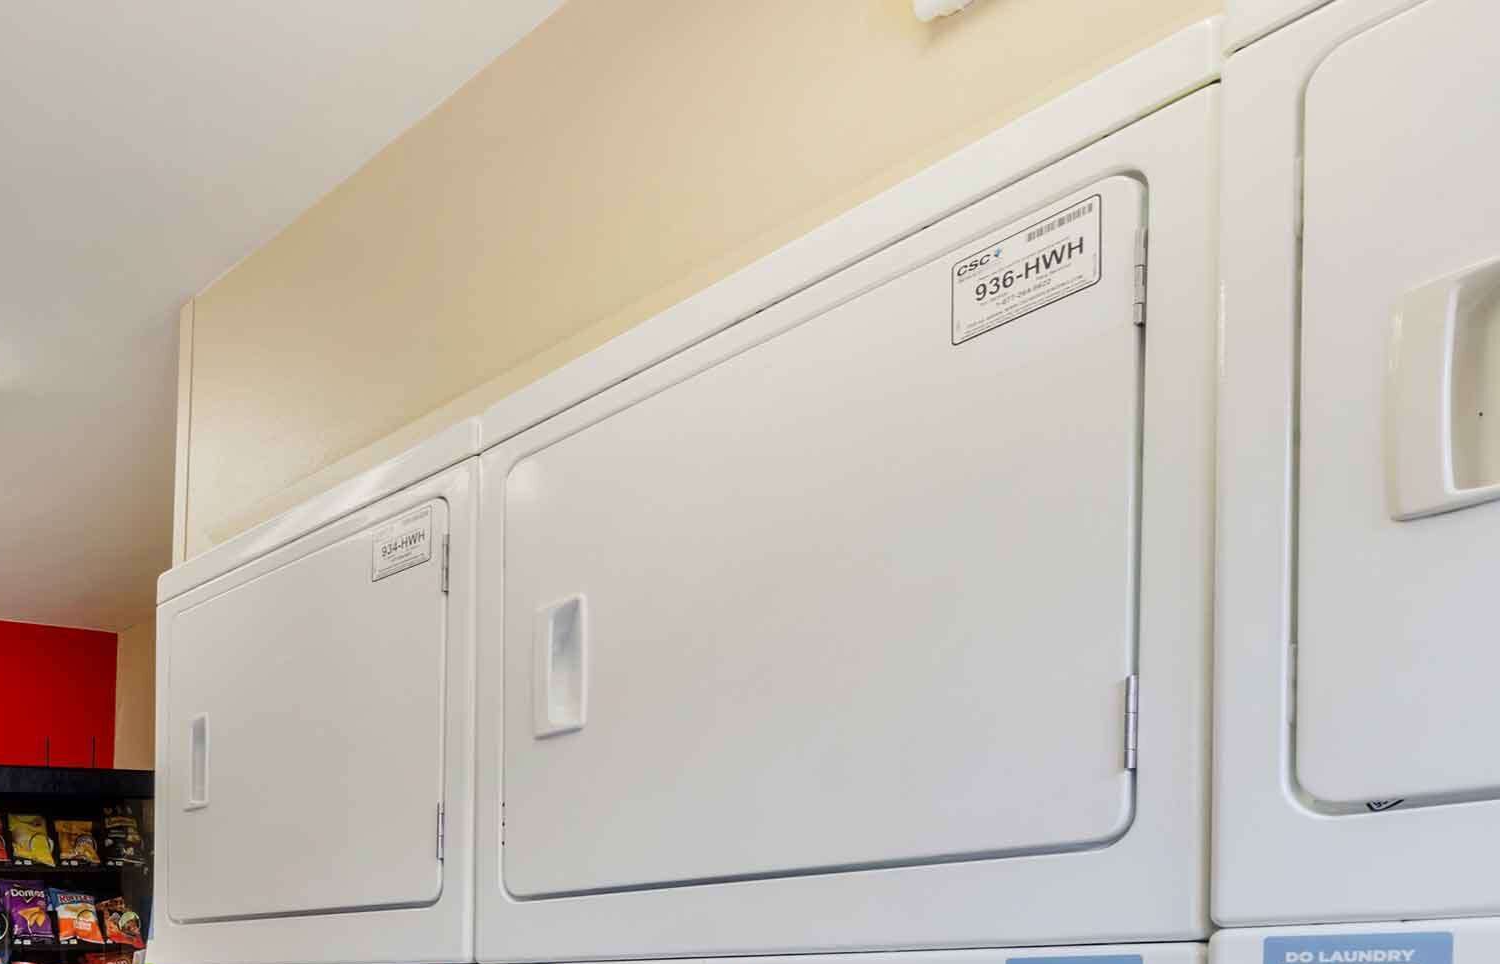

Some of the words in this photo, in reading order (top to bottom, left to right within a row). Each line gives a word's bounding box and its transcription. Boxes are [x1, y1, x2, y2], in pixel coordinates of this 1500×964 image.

[957, 254, 991, 277] CSC
[975, 236, 1084, 301] 936-HWH
[10, 888, 45, 898] Doritos
[1285, 951, 1313, 963] DO
[1318, 949, 1416, 962] LAUNDRY
